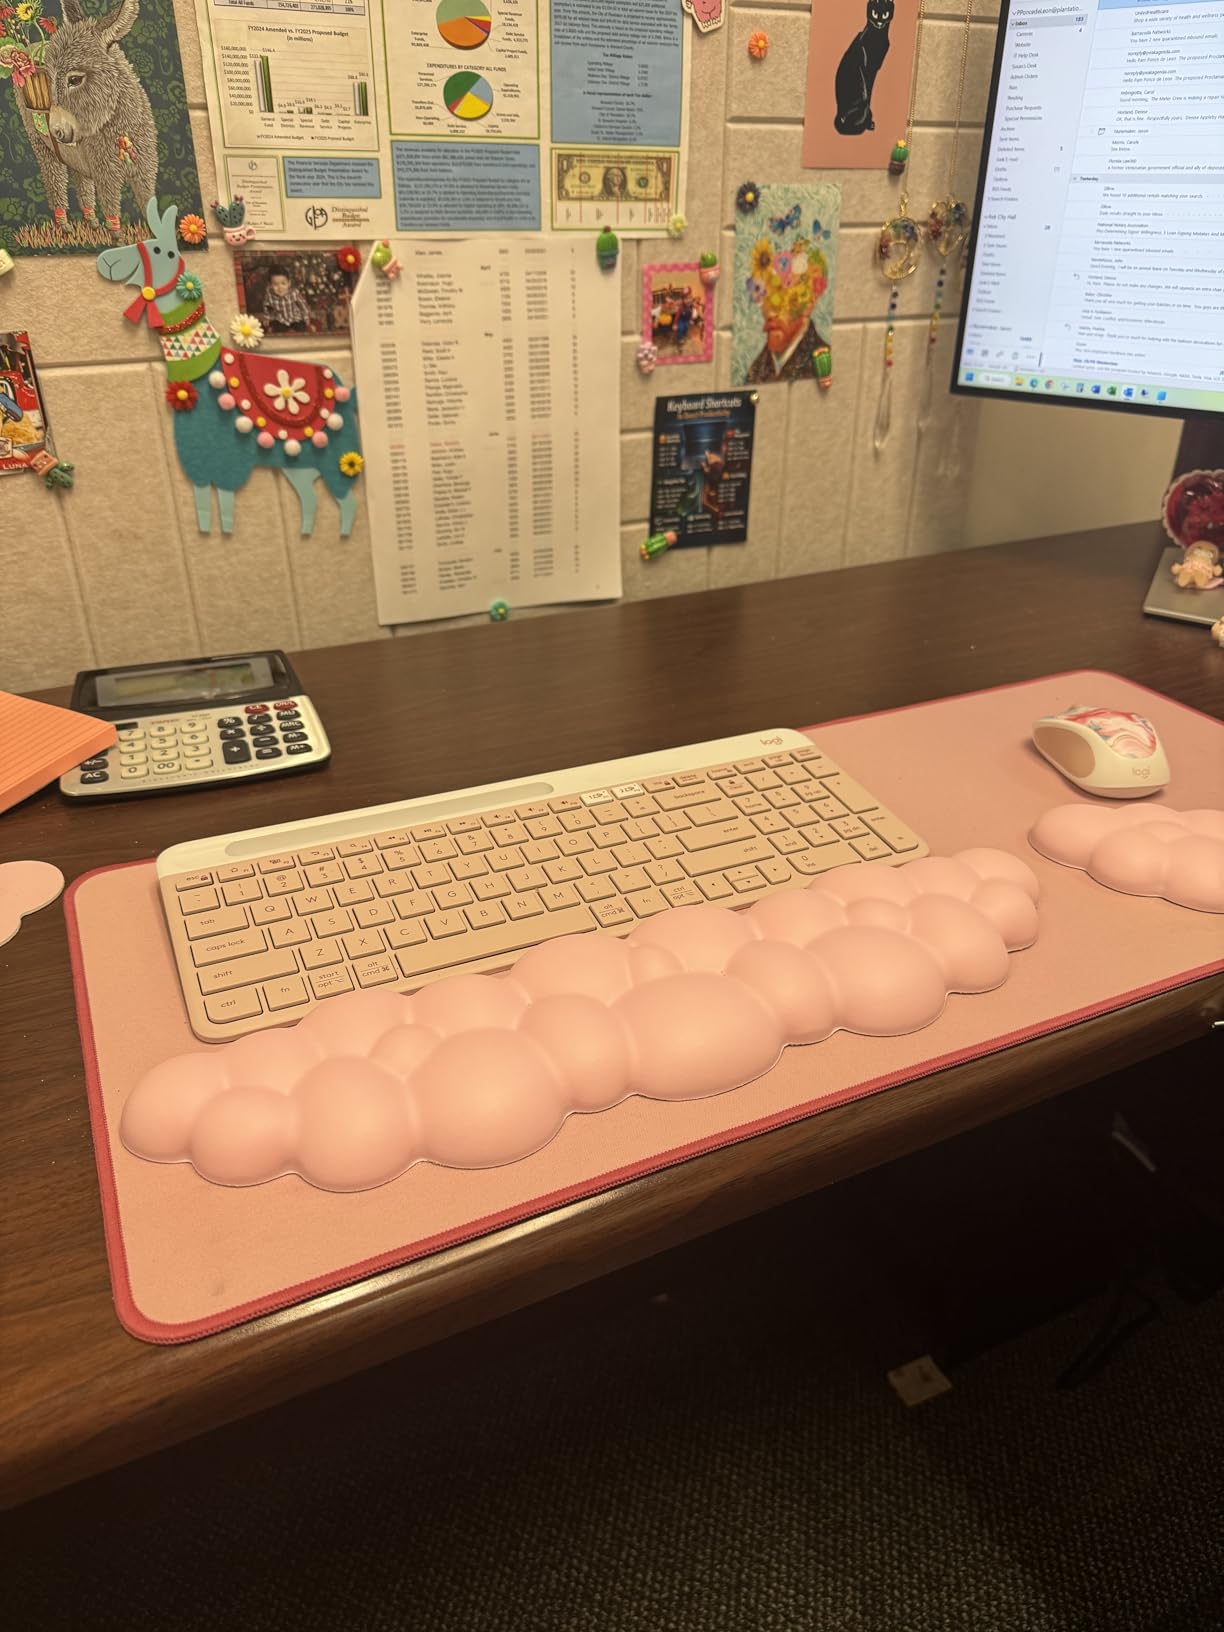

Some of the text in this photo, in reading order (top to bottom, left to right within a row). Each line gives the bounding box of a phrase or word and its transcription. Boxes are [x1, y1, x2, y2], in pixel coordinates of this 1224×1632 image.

[760, 736, 784, 746] logi
[1132, 767, 1150, 779] logi
[305, 895, 318, 903] W
[264, 905, 276, 913] Q
[400, 928, 410, 936] C
[206, 938, 245, 952] caps lock
[213, 969, 233, 979] shift
[318, 971, 340, 980] start
[361, 968, 381, 977] cmd
[318, 981, 333, 989] opt
[220, 999, 237, 1009] ctrl
